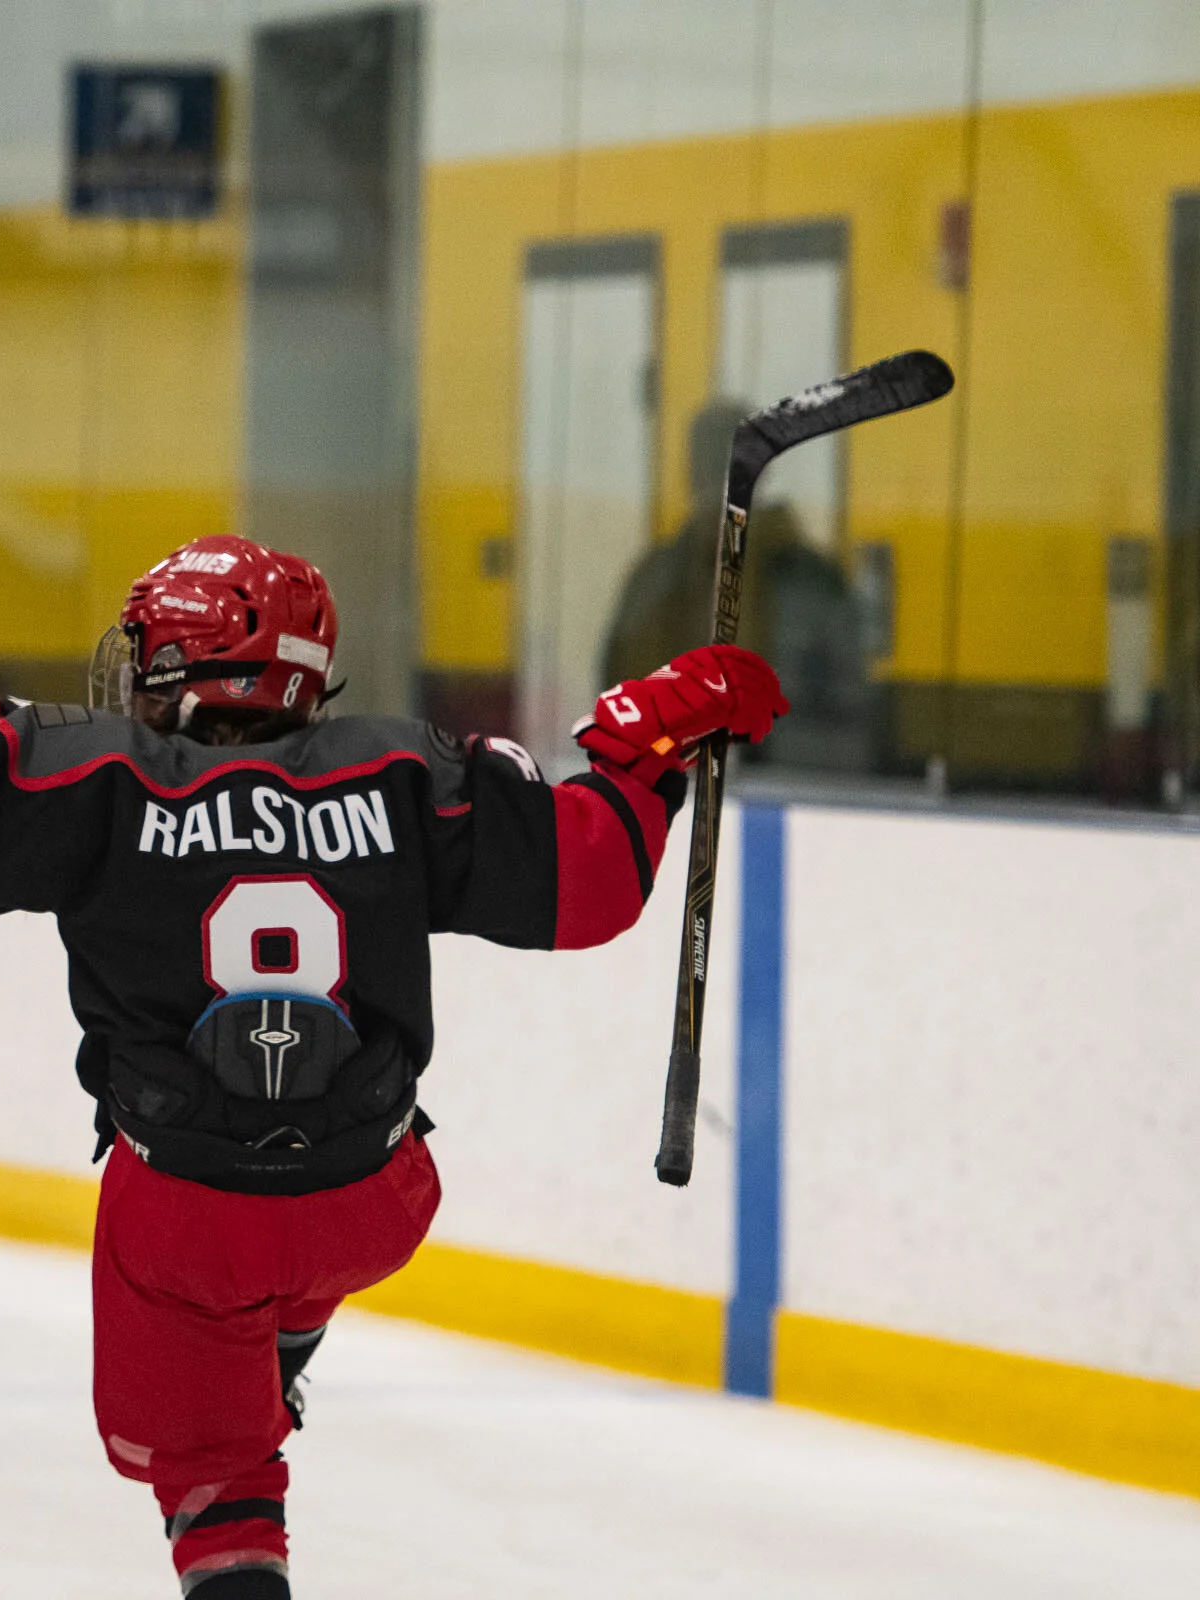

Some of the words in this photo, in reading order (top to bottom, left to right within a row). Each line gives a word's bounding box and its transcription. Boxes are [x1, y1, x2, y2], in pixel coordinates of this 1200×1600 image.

[145, 669, 187, 687] BAUER
[283, 672, 304, 708] 8
[138, 785, 396, 863] RALSTON
[693, 916, 706, 982] SUPREME
